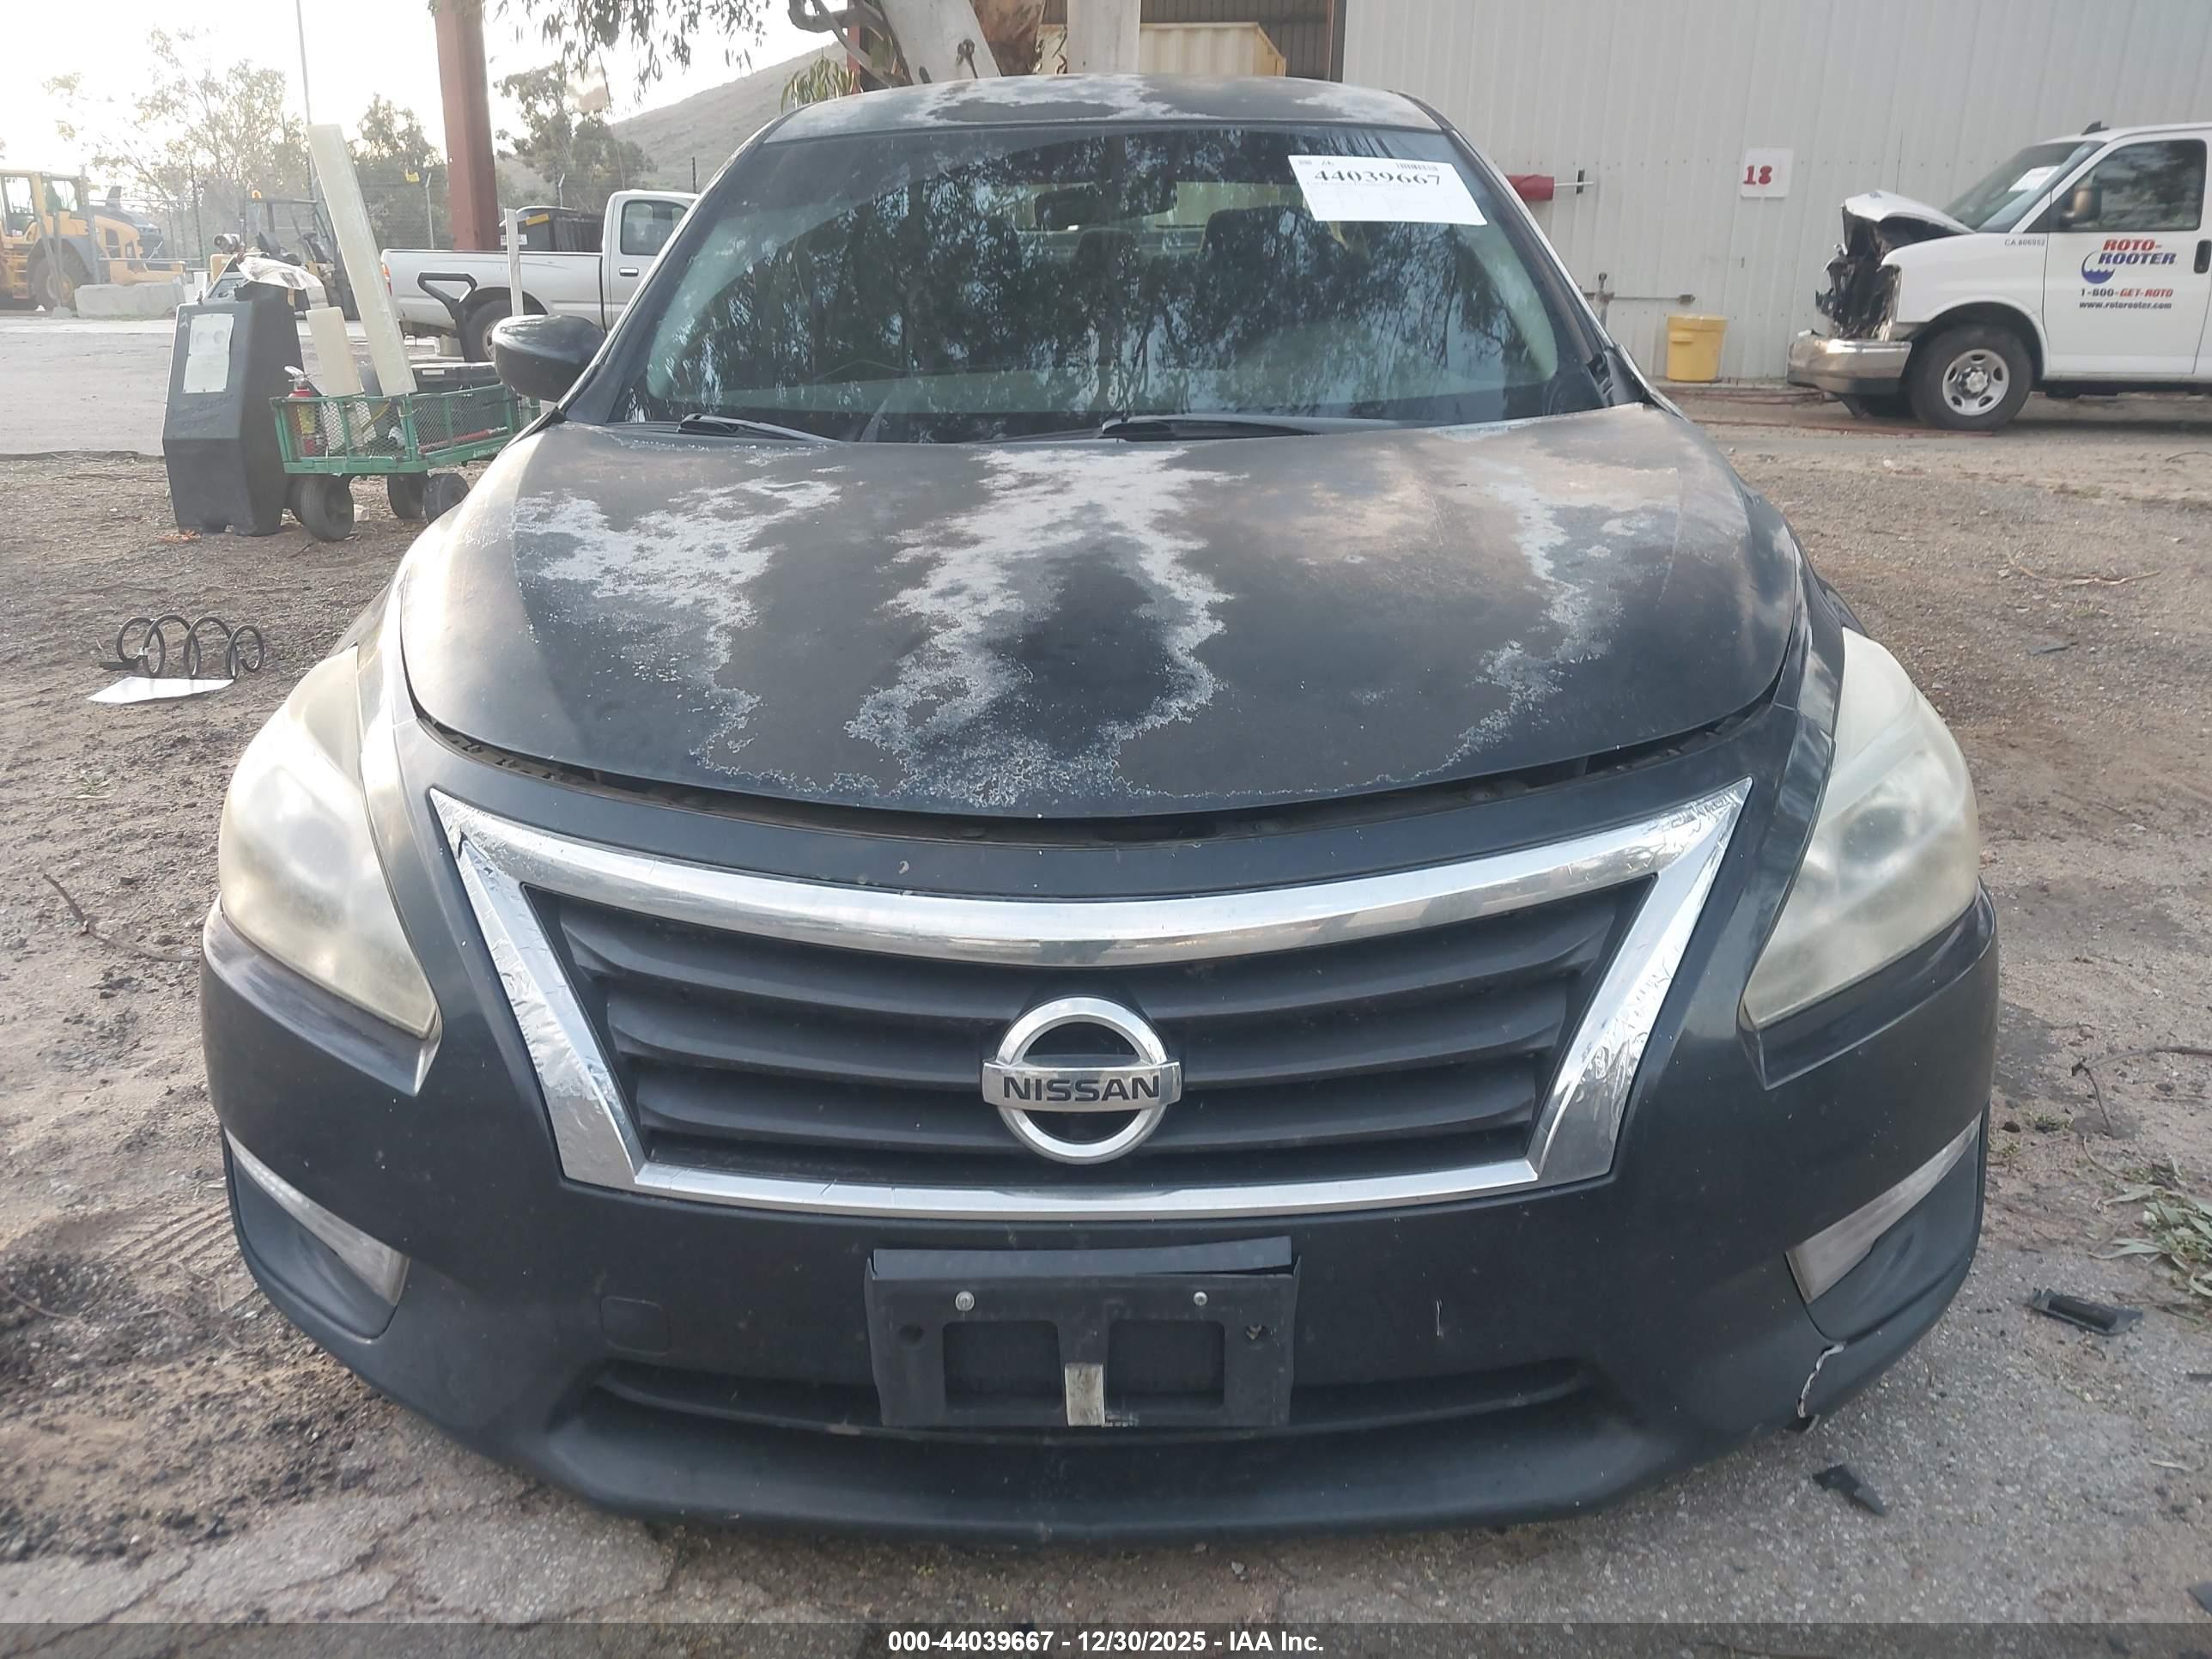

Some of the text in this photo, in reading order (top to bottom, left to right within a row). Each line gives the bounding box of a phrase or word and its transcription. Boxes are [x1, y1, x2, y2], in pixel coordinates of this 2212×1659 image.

[1314, 169, 1440, 186] 44039667
[1742, 165, 1773, 185] 18
[2102, 239, 2163, 252] ROTO-
[2097, 252, 2177, 265] ROOTER
[1003, 1075, 1160, 1103] NISSAN
